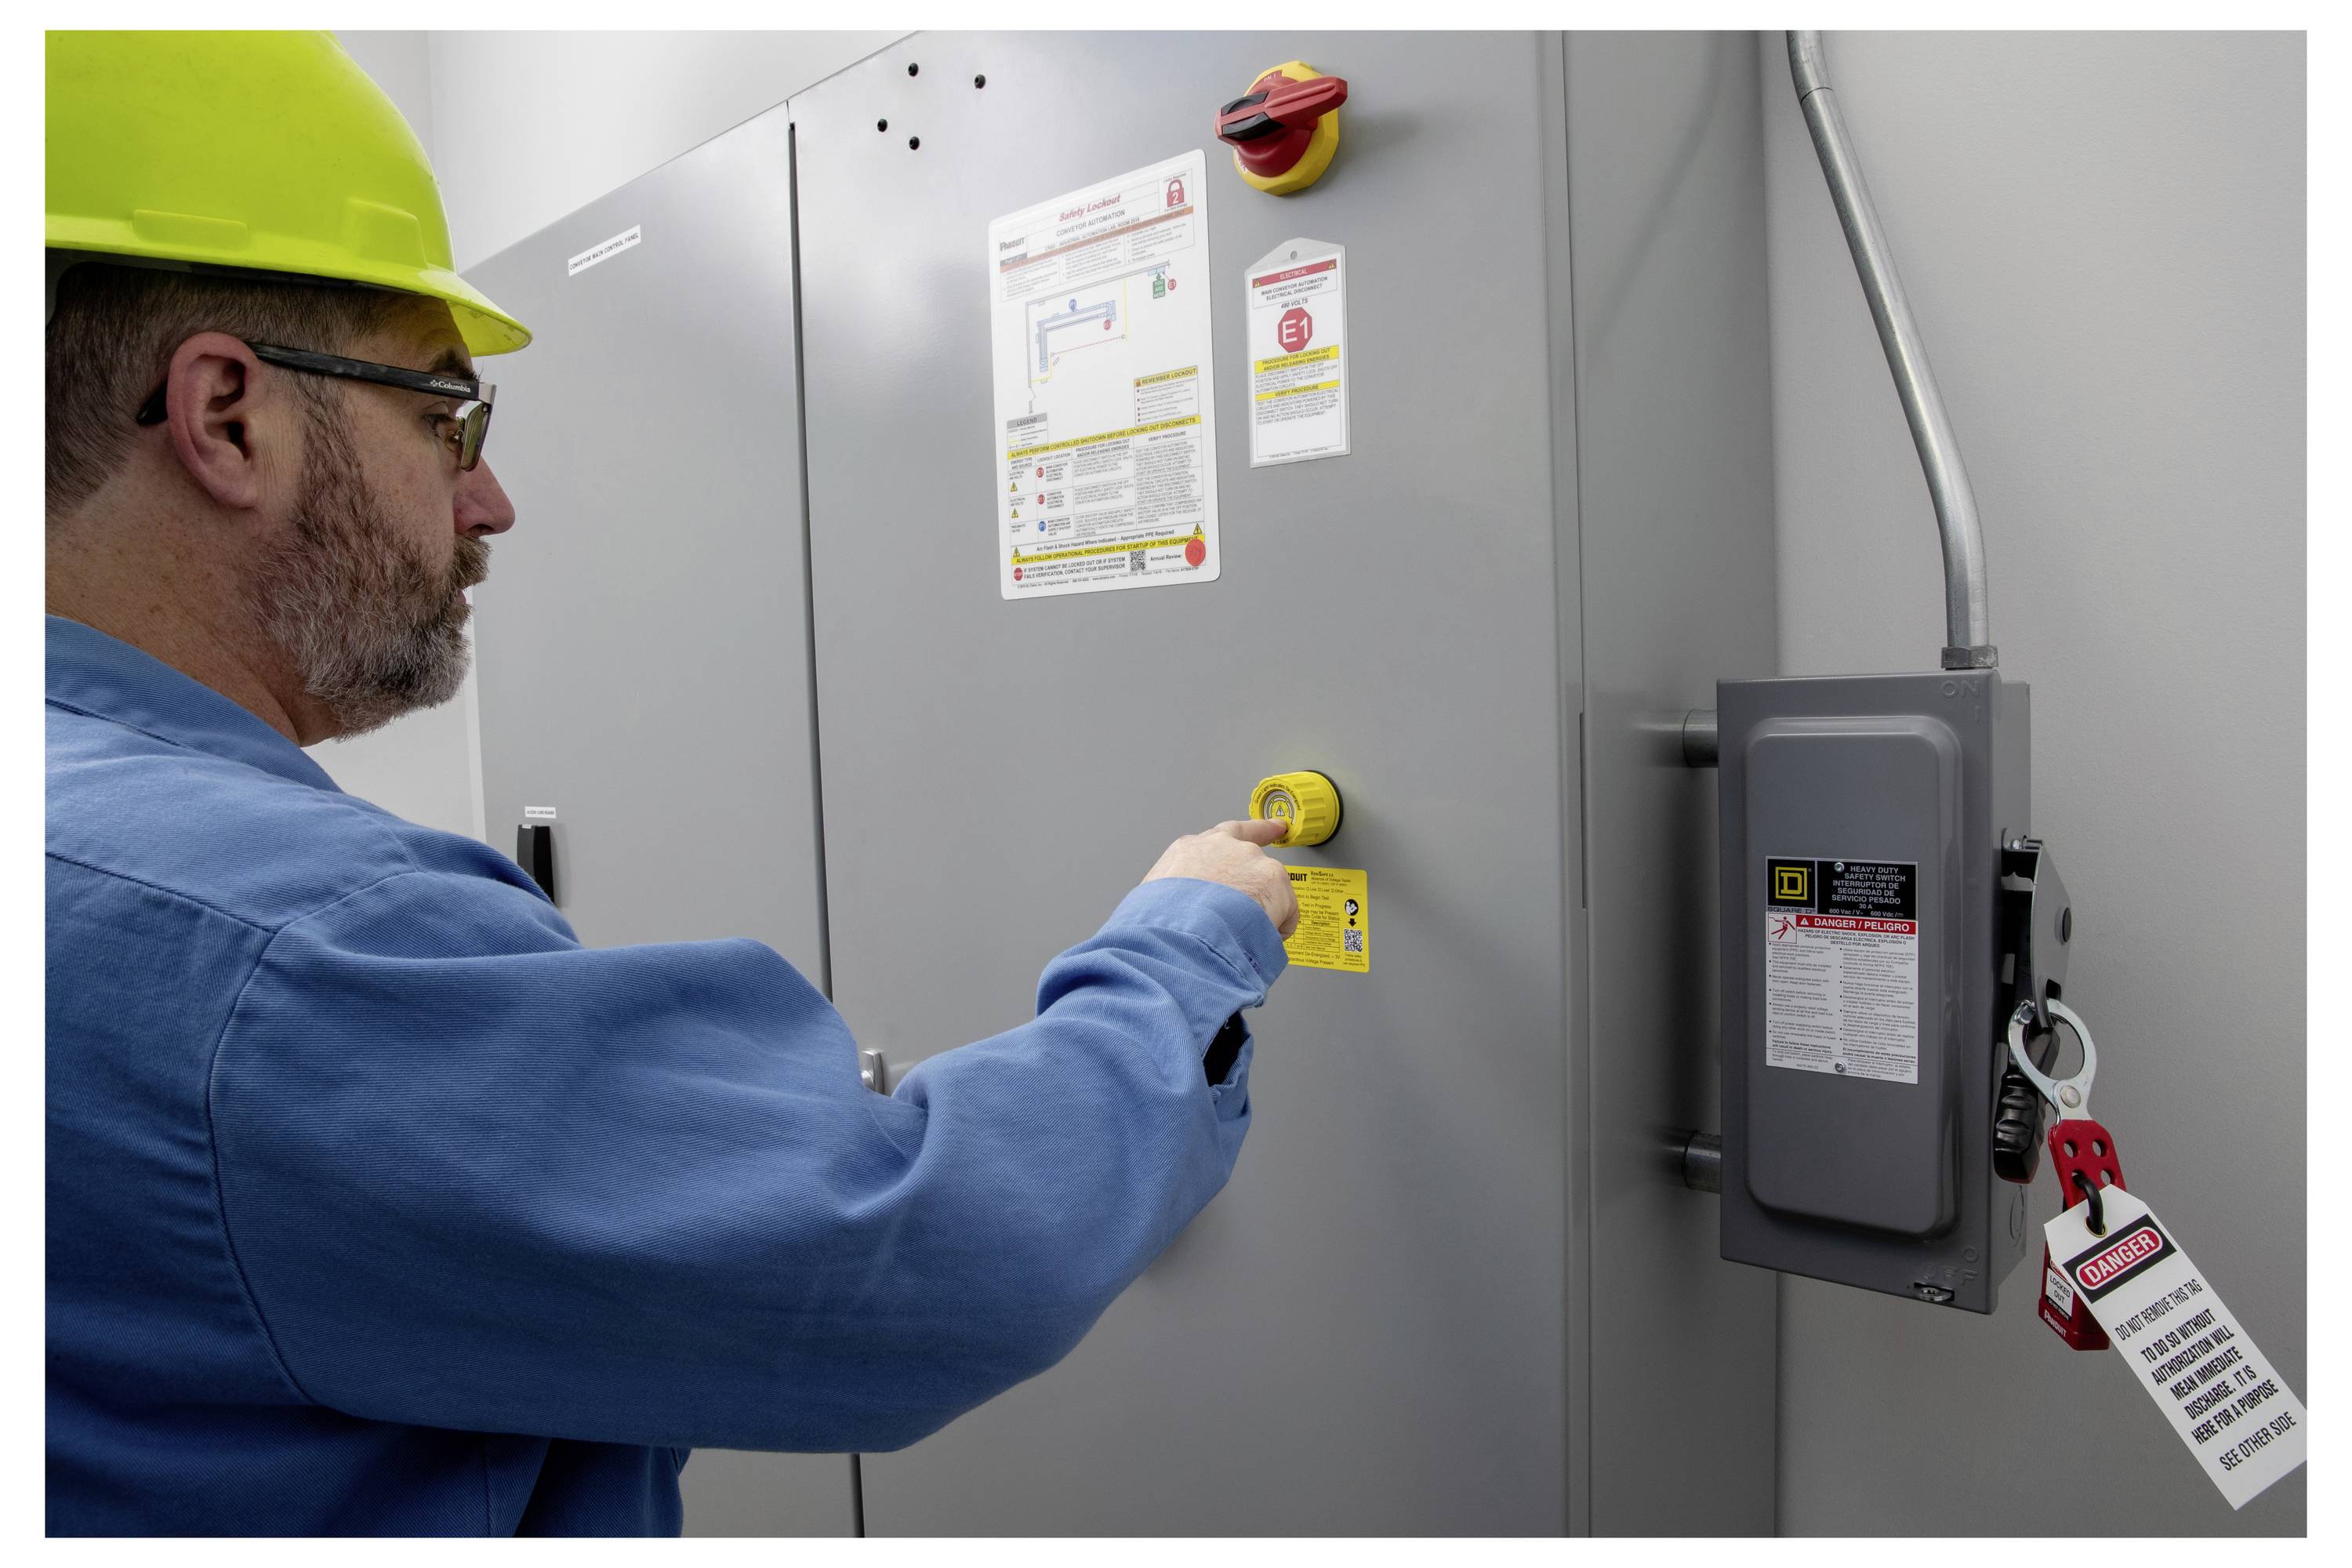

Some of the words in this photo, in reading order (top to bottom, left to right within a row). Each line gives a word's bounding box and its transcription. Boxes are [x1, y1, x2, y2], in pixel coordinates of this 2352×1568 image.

[1173, 192, 1178, 204] 2
[1059, 207, 1085, 221] Safety
[1087, 194, 1121, 212] Lockout
[1057, 223, 1087, 237] CONVEYOR
[1088, 209, 1125, 227] AUTOMATION
[569, 256, 591, 270] CONVEYOR
[592, 250, 604, 259] MAIN
[604, 240, 623, 253] CONTROL
[625, 232, 639, 243] PANEL
[1279, 269, 1307, 280] ELECTRICAL
[1267, 292, 1293, 300] ELECTRICAL
[1294, 284, 1323, 294] DISCONNECT
[1273, 283, 1298, 293] CONVEYOR
[1298, 276, 1327, 286] AUTOMATION
[1290, 298, 1308, 307] VOLTS
[1283, 317, 1308, 343] E1
[1262, 356, 1288, 365] PROCEDURE
[1281, 359, 1306, 368] RELEASING
[1307, 354, 1330, 363] ENERGIES
[1142, 375, 1170, 384] REMEMBER
[1171, 368, 1196, 378] LOCKOUT
[439, 381, 470, 392] Columbia
[1291, 384, 1318, 394] PROCEDURE
[1017, 417, 1036, 426] LEGEND
[1051, 441, 1080, 450] CONTROLLED
[1080, 435, 1105, 444] SHUTDOWN
[1127, 426, 1148, 435] LOCKING
[1160, 417, 1196, 429] DISCONNECTS
[1084, 546, 1116, 555] PROCEDURES
[1941, 680, 1981, 699] ON
[1287, 873, 1308, 882] DUIT
[1814, 918, 1857, 928] DANGER
[1858, 920, 1862, 929] /
[1864, 921, 1910, 932] PELIGRO
[2084, 1233, 2156, 1283] DANGER
[2049, 1275, 2070, 1298] LOCKED
[2054, 1290, 2065, 1304] OUT
[2114, 1324, 2131, 1341] DO
[2125, 1314, 2145, 1334] NOT
[2140, 1297, 2173, 1325] REMOVE
[2168, 1287, 2189, 1306] THIS
[2183, 1278, 2203, 1297] TAG
[2140, 1347, 2158, 1363] TO
[2152, 1339, 2169, 1356] DO
[2165, 1331, 2181, 1348] SO
[2176, 1308, 2216, 1341] WITHOUT
[2151, 1336, 2216, 1386] AUTHORIZATION
[2209, 1325, 2234, 1346] WILL
[2169, 1374, 2199, 1401] MEAN
[2194, 1346, 2243, 1385] IMMEDIATE
[2184, 1380, 2237, 1421] DISCHARGE.
[2233, 1370, 2247, 1387] IT
[2242, 1365, 2257, 1381] IS
[2191, 1420, 2219, 1445] HERE
[2212, 1408, 2236, 1430] FOR
[2230, 1403, 2243, 1418] A
[2237, 1378, 2279, 1414] PURPOSE
[2219, 1449, 2243, 1471] SEE
[2238, 1427, 2275, 1457] OTHER
[2269, 1411, 2297, 1436] SIDE
